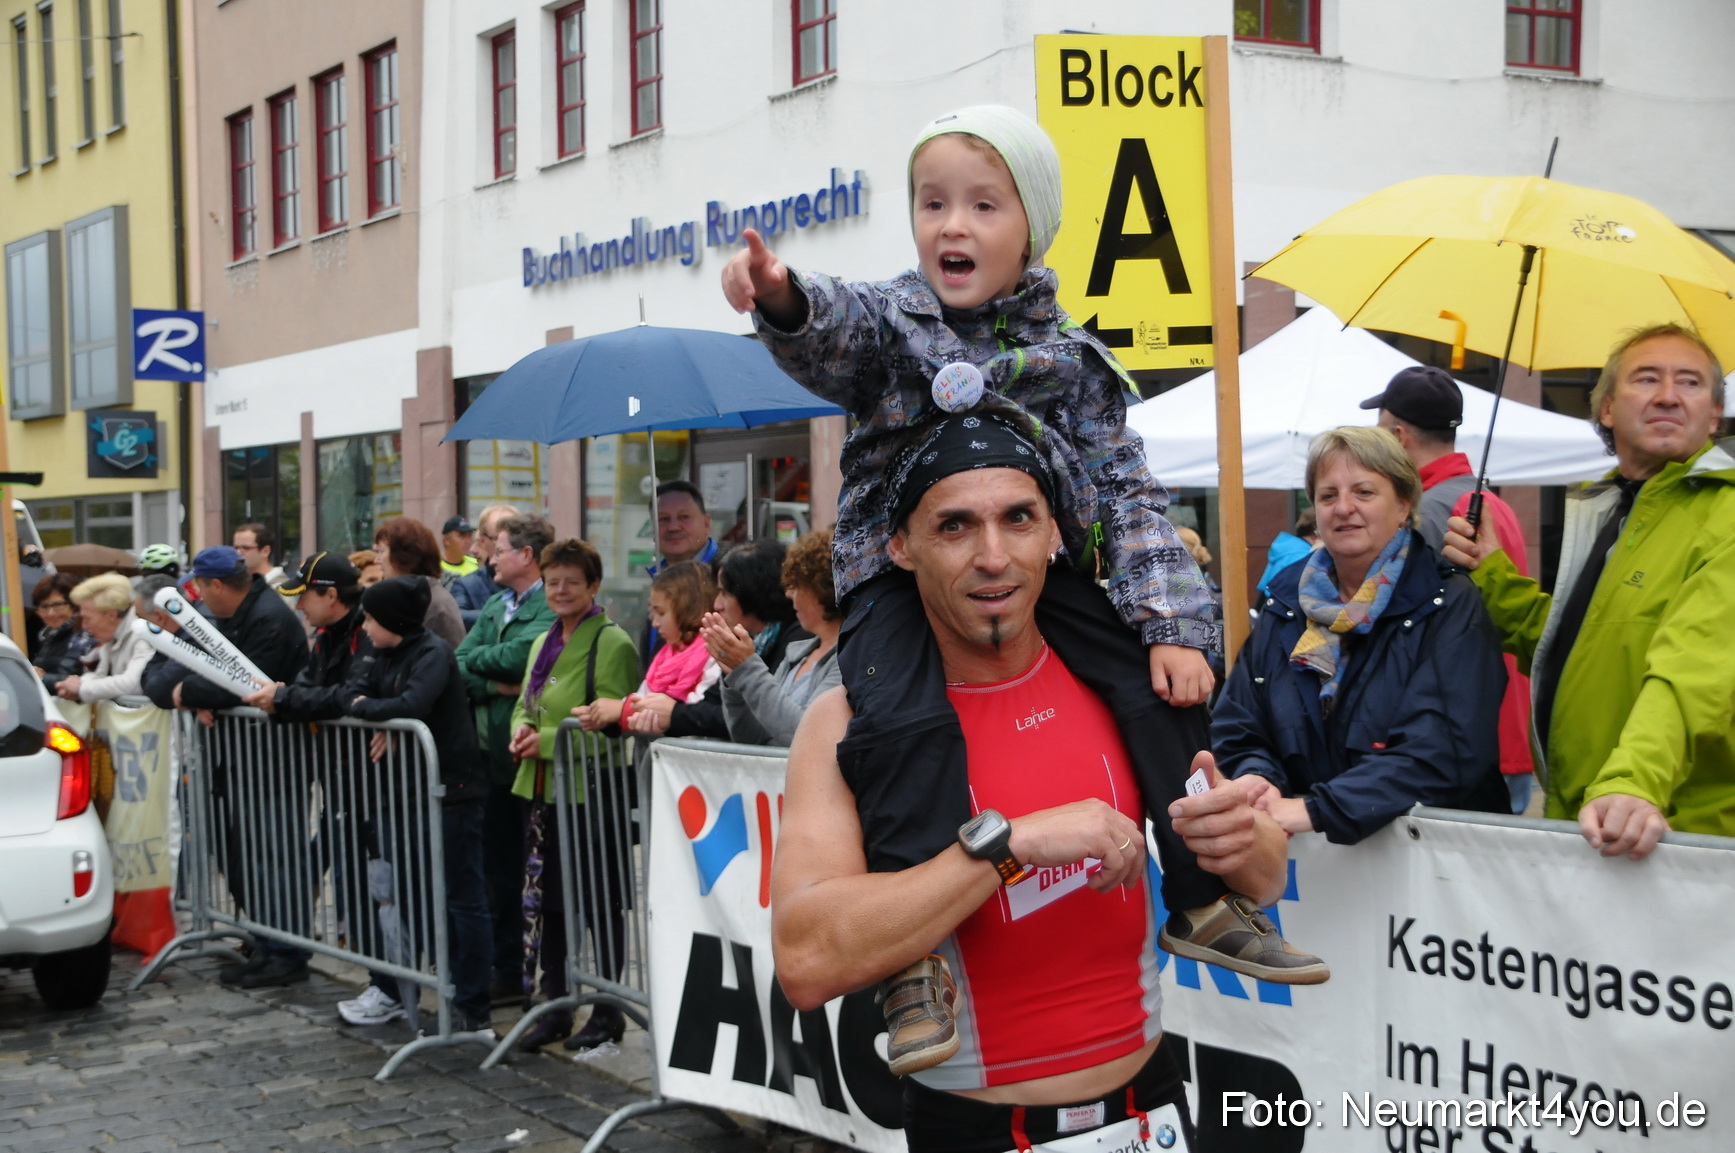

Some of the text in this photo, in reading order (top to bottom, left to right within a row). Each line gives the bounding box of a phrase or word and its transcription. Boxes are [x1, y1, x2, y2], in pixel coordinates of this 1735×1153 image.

[1060, 48, 1204, 108] Block
[523, 167, 865, 287] Buchhandlung Rupprecht
[1085, 137, 1193, 297] A
[114, 428, 138, 457] G2
[1015, 706, 1056, 731] Lance
[1387, 913, 1734, 1030] Kastengasse
[1385, 1023, 1650, 1138] Im Herzen
